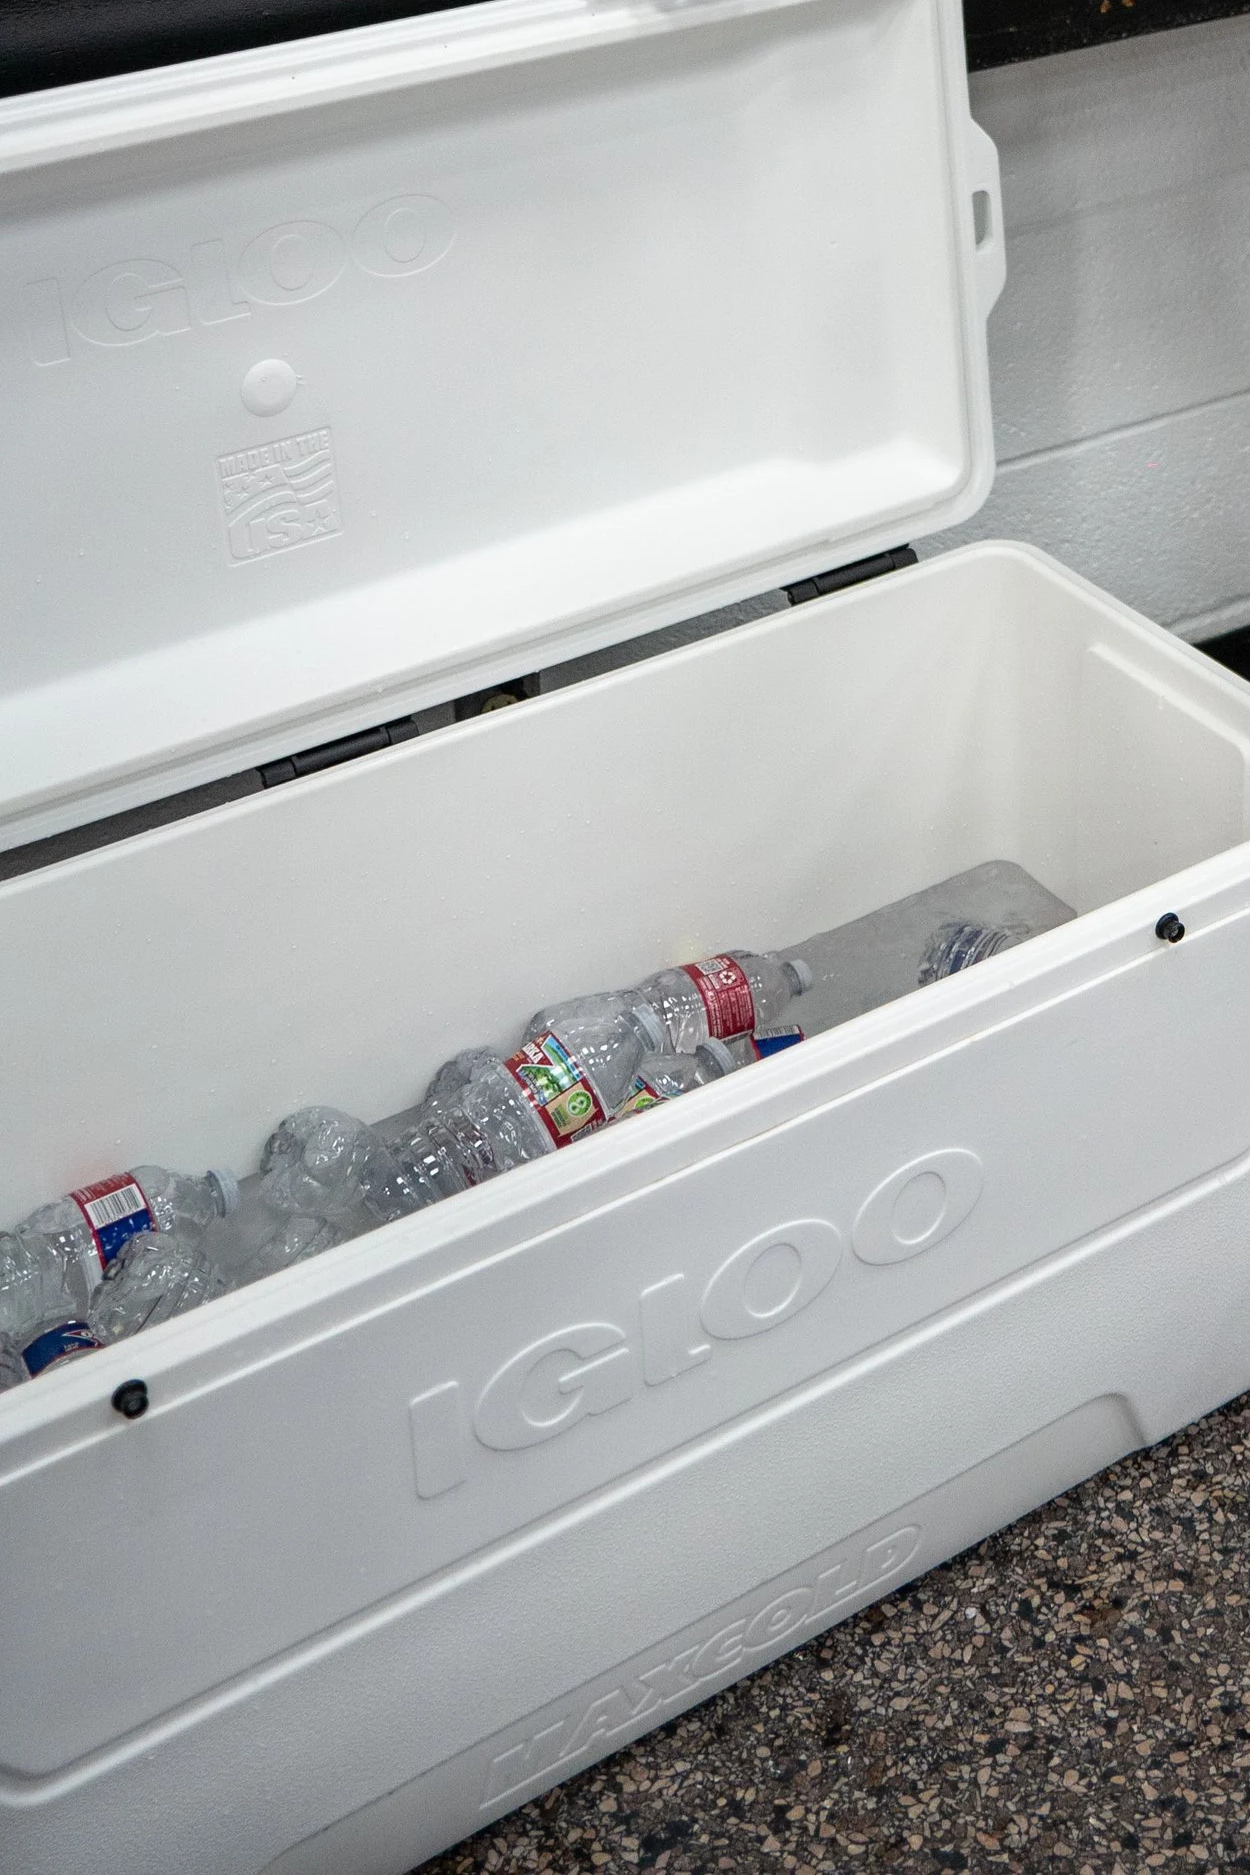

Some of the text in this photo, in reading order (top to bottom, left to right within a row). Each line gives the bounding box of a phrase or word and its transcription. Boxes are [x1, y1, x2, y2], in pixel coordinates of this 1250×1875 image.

[24, 192, 458, 368] IGLOO
[219, 428, 331, 478] MADE IN THE
[409, 1147, 985, 1501] IGLOO
[479, 1524, 924, 1811] MAXCOLD
